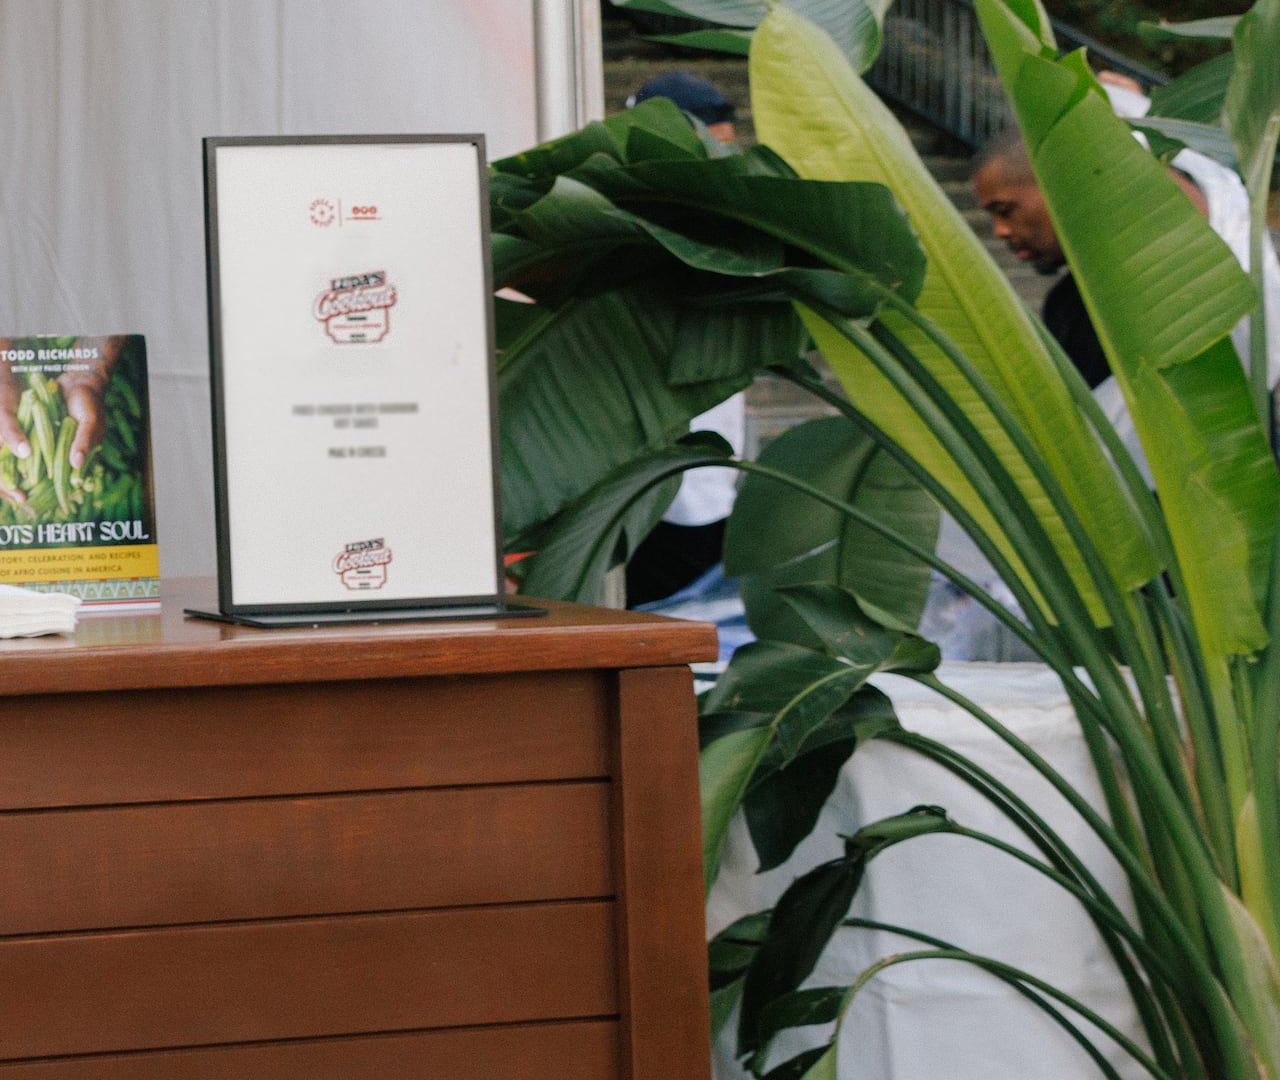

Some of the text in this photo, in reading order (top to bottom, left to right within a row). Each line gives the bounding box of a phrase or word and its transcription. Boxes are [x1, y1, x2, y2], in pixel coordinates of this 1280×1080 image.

[0, 348, 98, 361] TODD RICHARDS
[37, 522, 95, 543] HEART
[99, 520, 150, 541] SOUL
[89, 553, 107, 561] AND
[109, 551, 141, 559] RECIPES
[13, 569, 35, 577] AFRO
[37, 567, 71, 575] CUISINE
[86, 565, 122, 573] AMERICA
